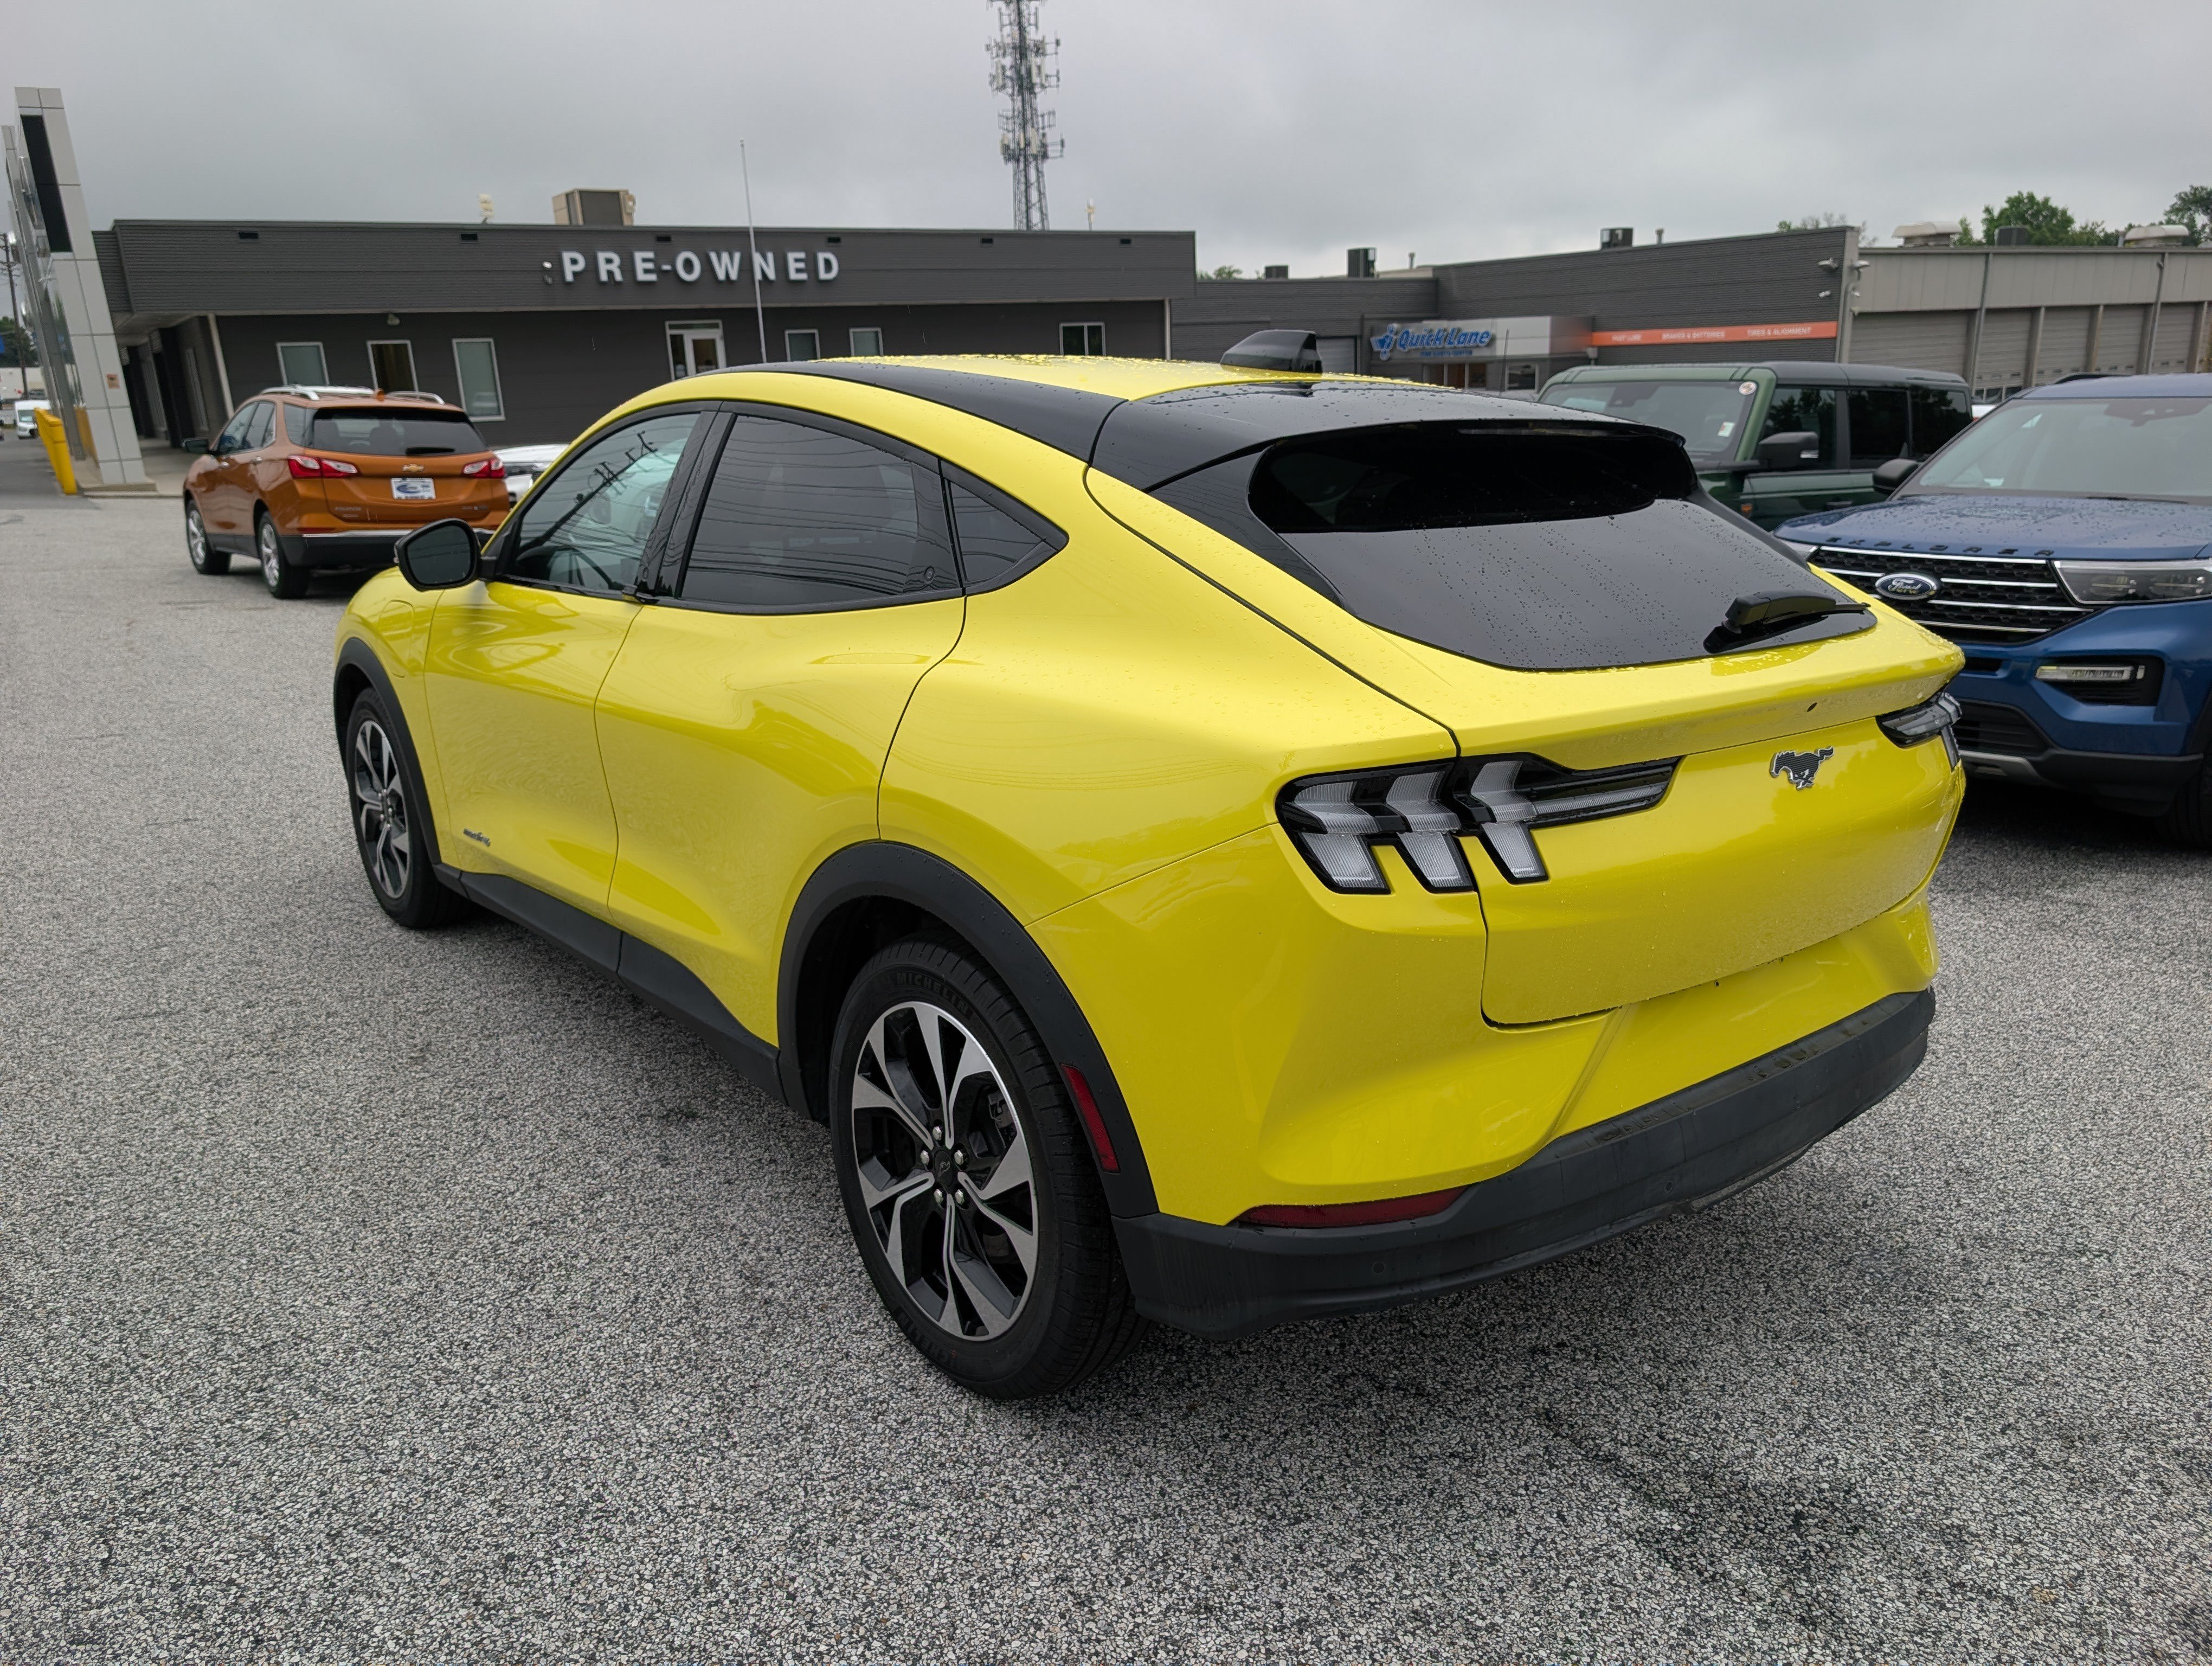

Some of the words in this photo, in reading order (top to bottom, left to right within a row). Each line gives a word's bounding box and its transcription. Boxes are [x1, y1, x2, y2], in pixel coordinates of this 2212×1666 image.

[561, 250, 840, 284] PRE-OWNED
[1397, 326, 1448, 352] Quick
[1445, 326, 1491, 348] Lane
[1887, 578, 1922, 594] Ford
[896, 972, 970, 1015] MICHELIN
